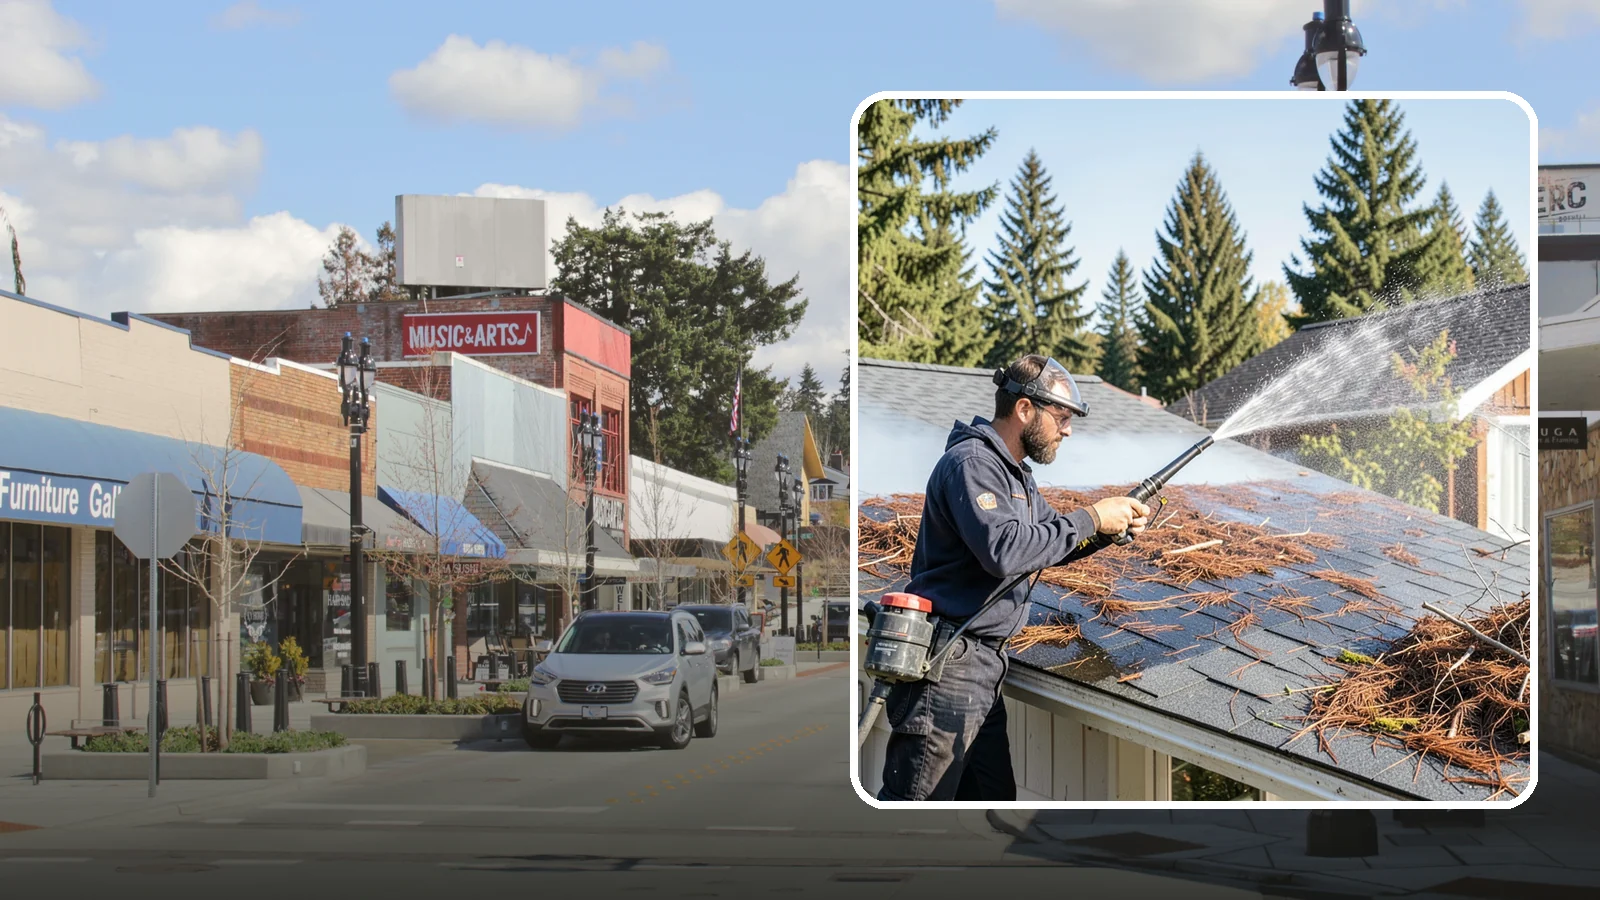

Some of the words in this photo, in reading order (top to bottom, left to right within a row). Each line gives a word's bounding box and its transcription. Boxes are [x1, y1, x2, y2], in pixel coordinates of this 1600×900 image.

[1540, 427, 1577, 437] UGA
[0, 471, 79, 515] Furniture
[89, 482, 122, 519] Gal
